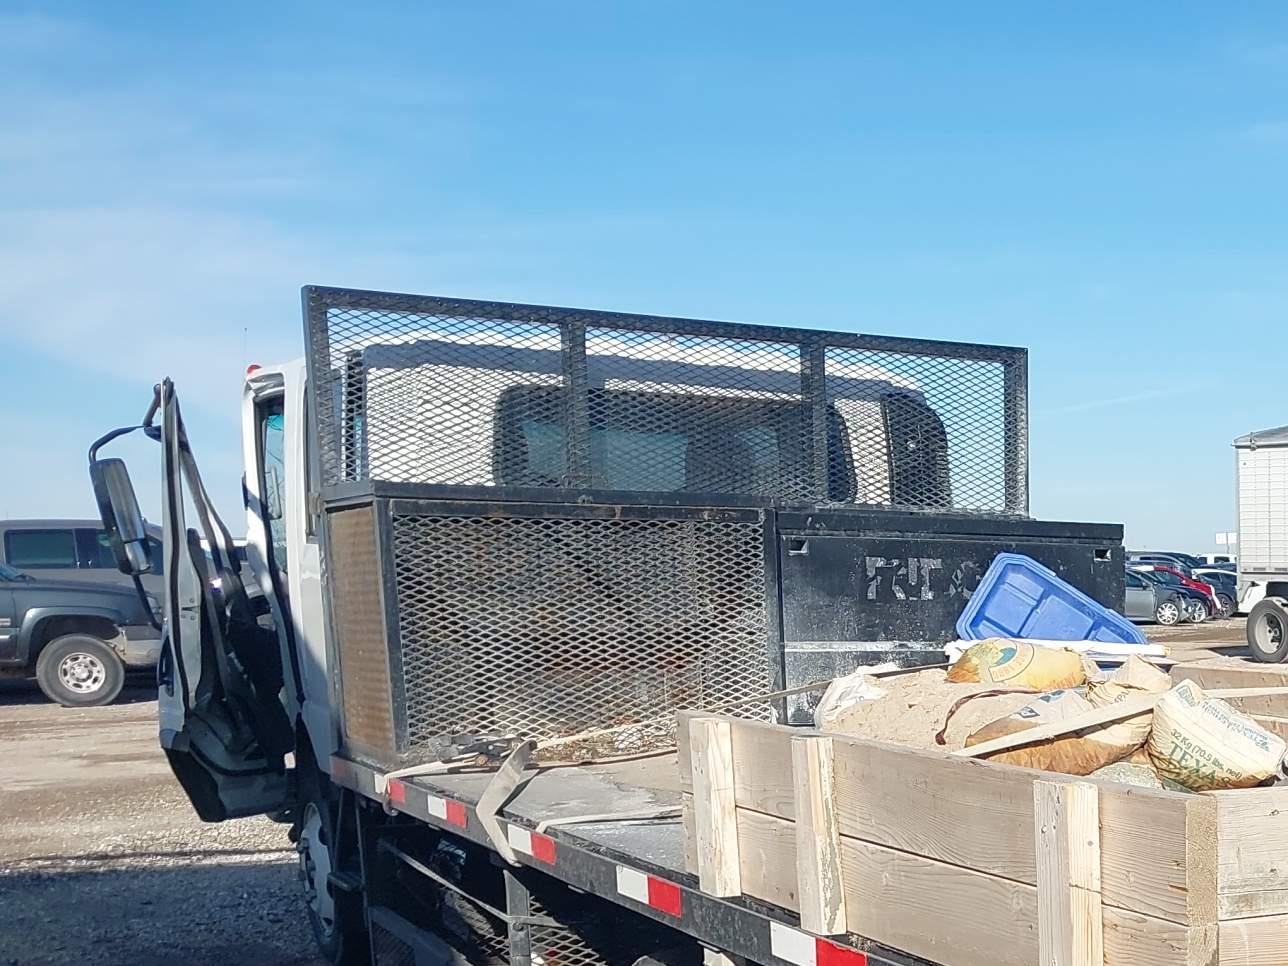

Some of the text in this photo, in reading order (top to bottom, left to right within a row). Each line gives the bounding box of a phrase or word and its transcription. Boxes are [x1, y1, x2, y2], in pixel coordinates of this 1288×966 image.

[1170, 729, 1182, 740] 32
[1181, 737, 1193, 751] Kg
[1225, 767, 1243, 779] net)
